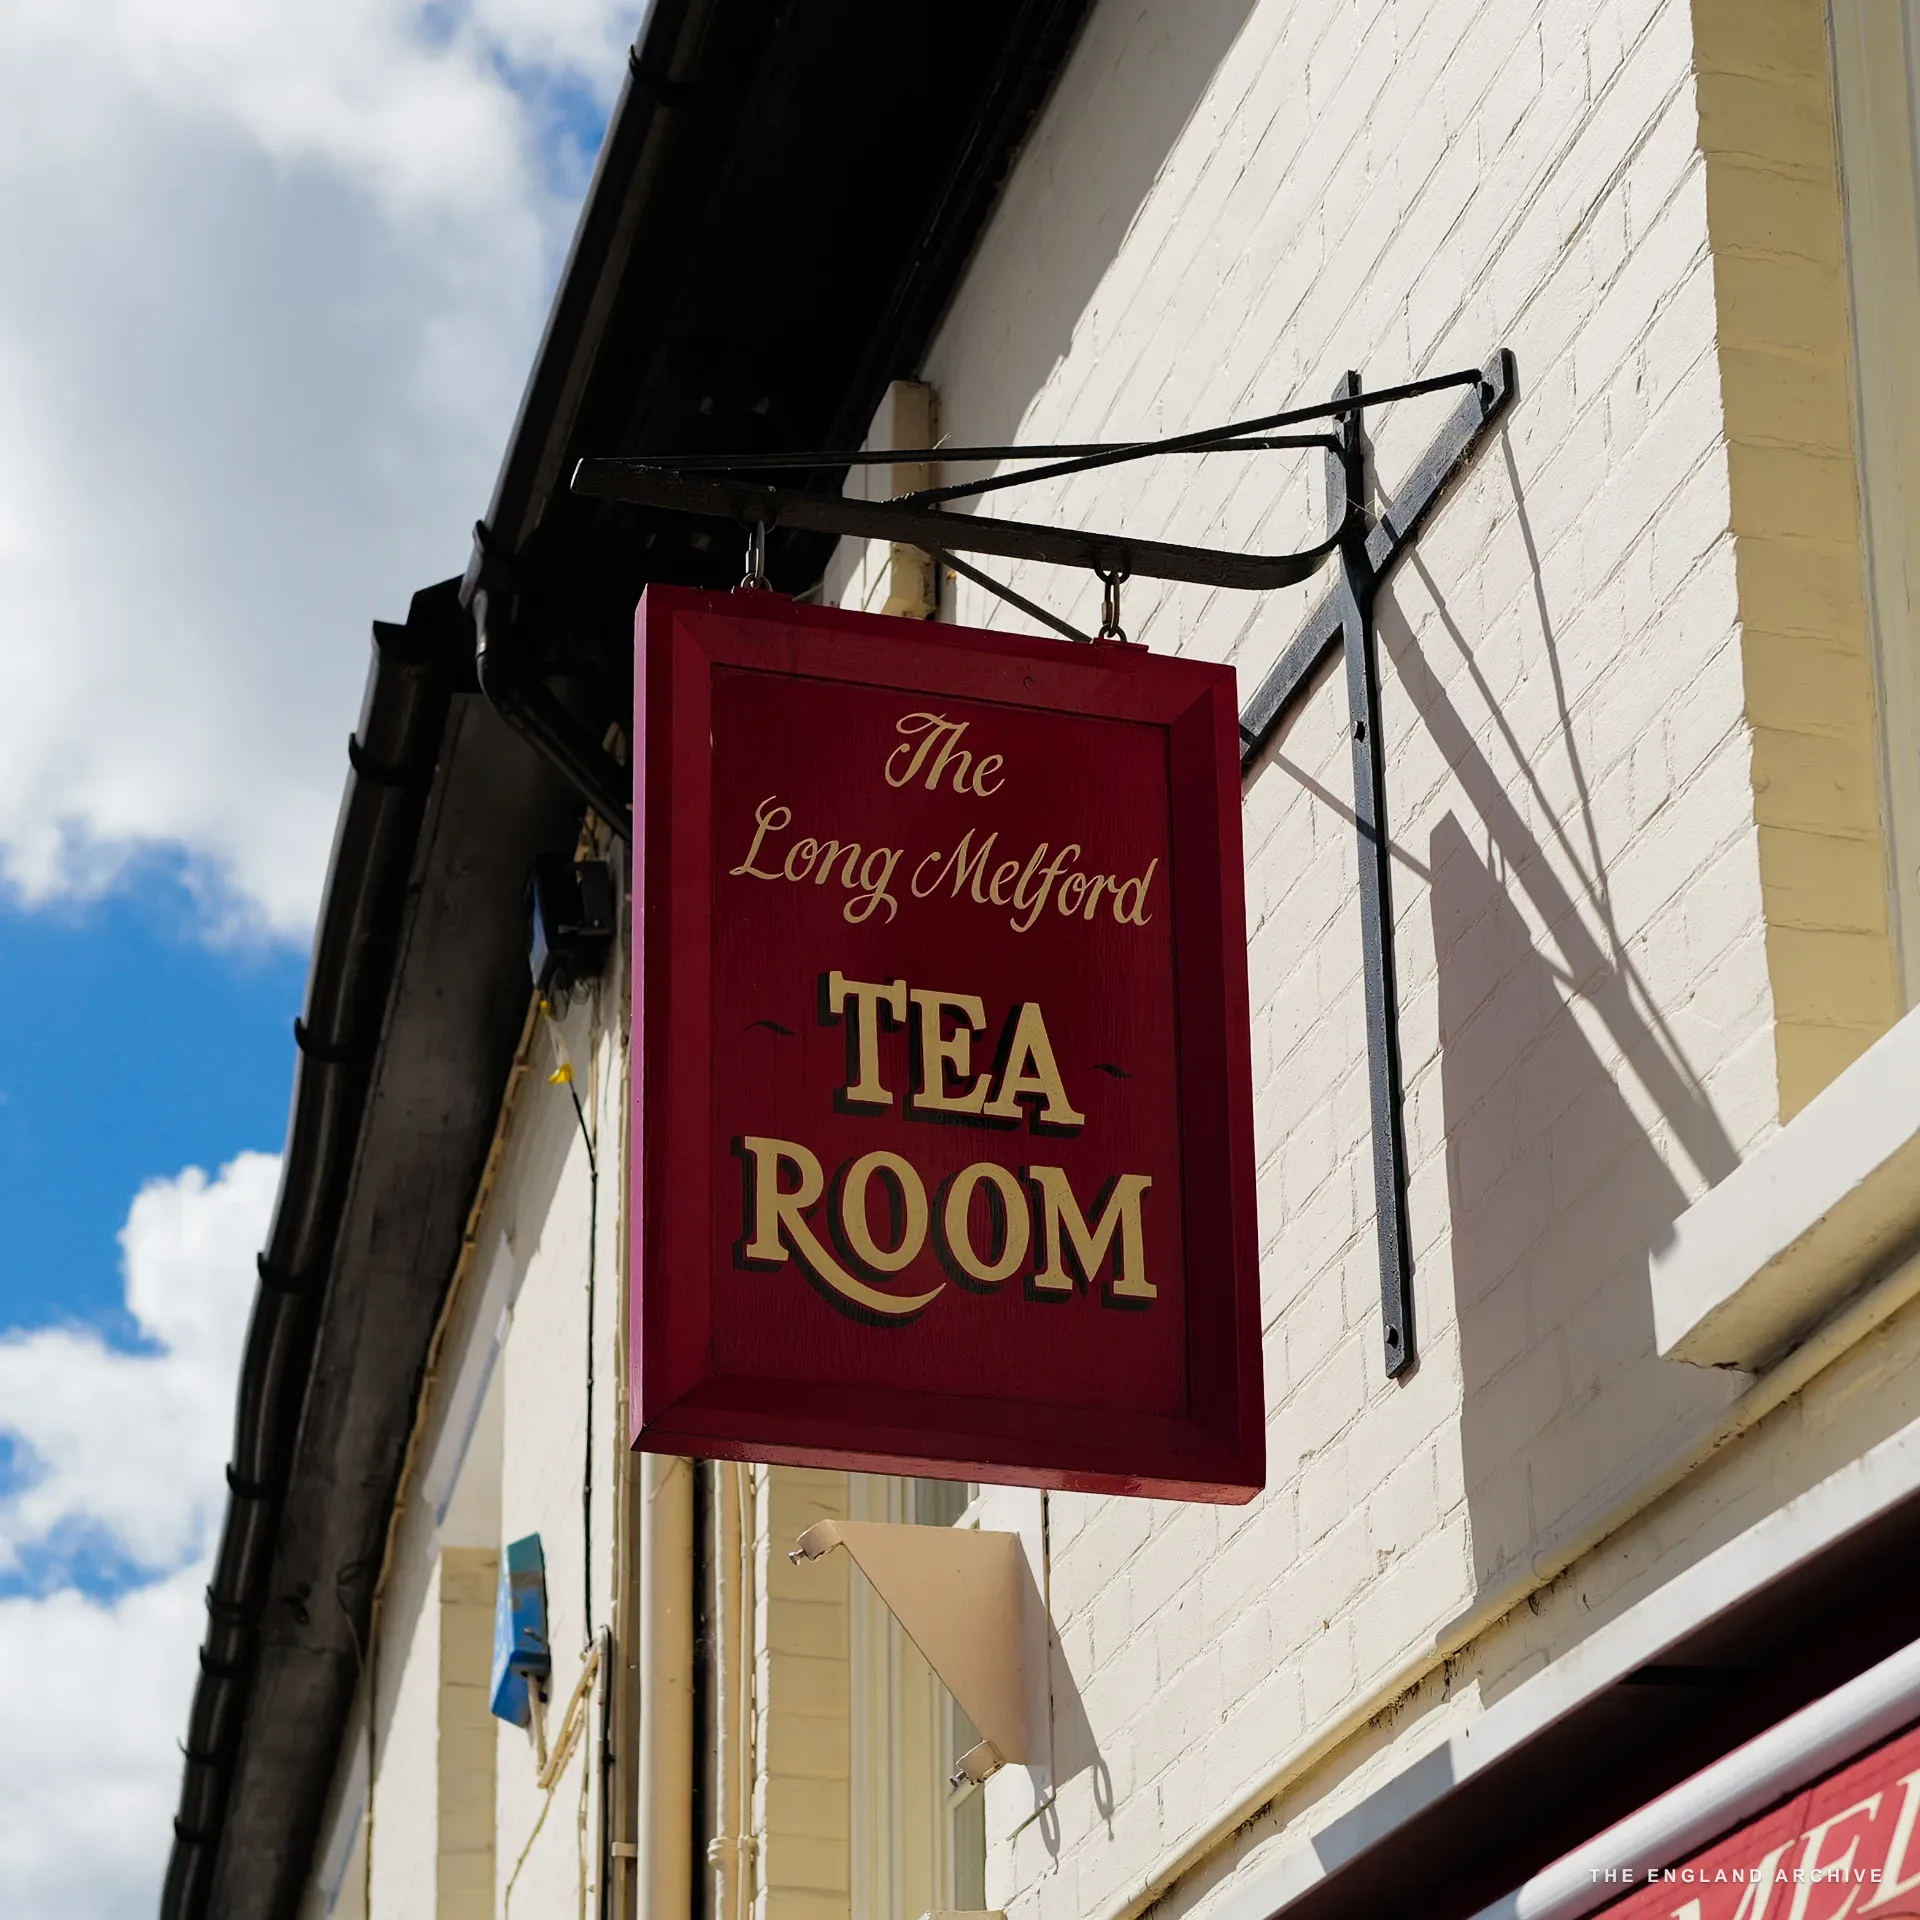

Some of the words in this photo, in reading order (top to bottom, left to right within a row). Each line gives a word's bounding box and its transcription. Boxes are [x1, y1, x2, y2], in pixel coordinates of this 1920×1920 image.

[884, 712, 1006, 797] The
[728, 795, 904, 924] Long
[911, 828, 1159, 933] Melford
[823, 969, 1086, 1130] TEA
[736, 1134, 1160, 1320] ROOM
